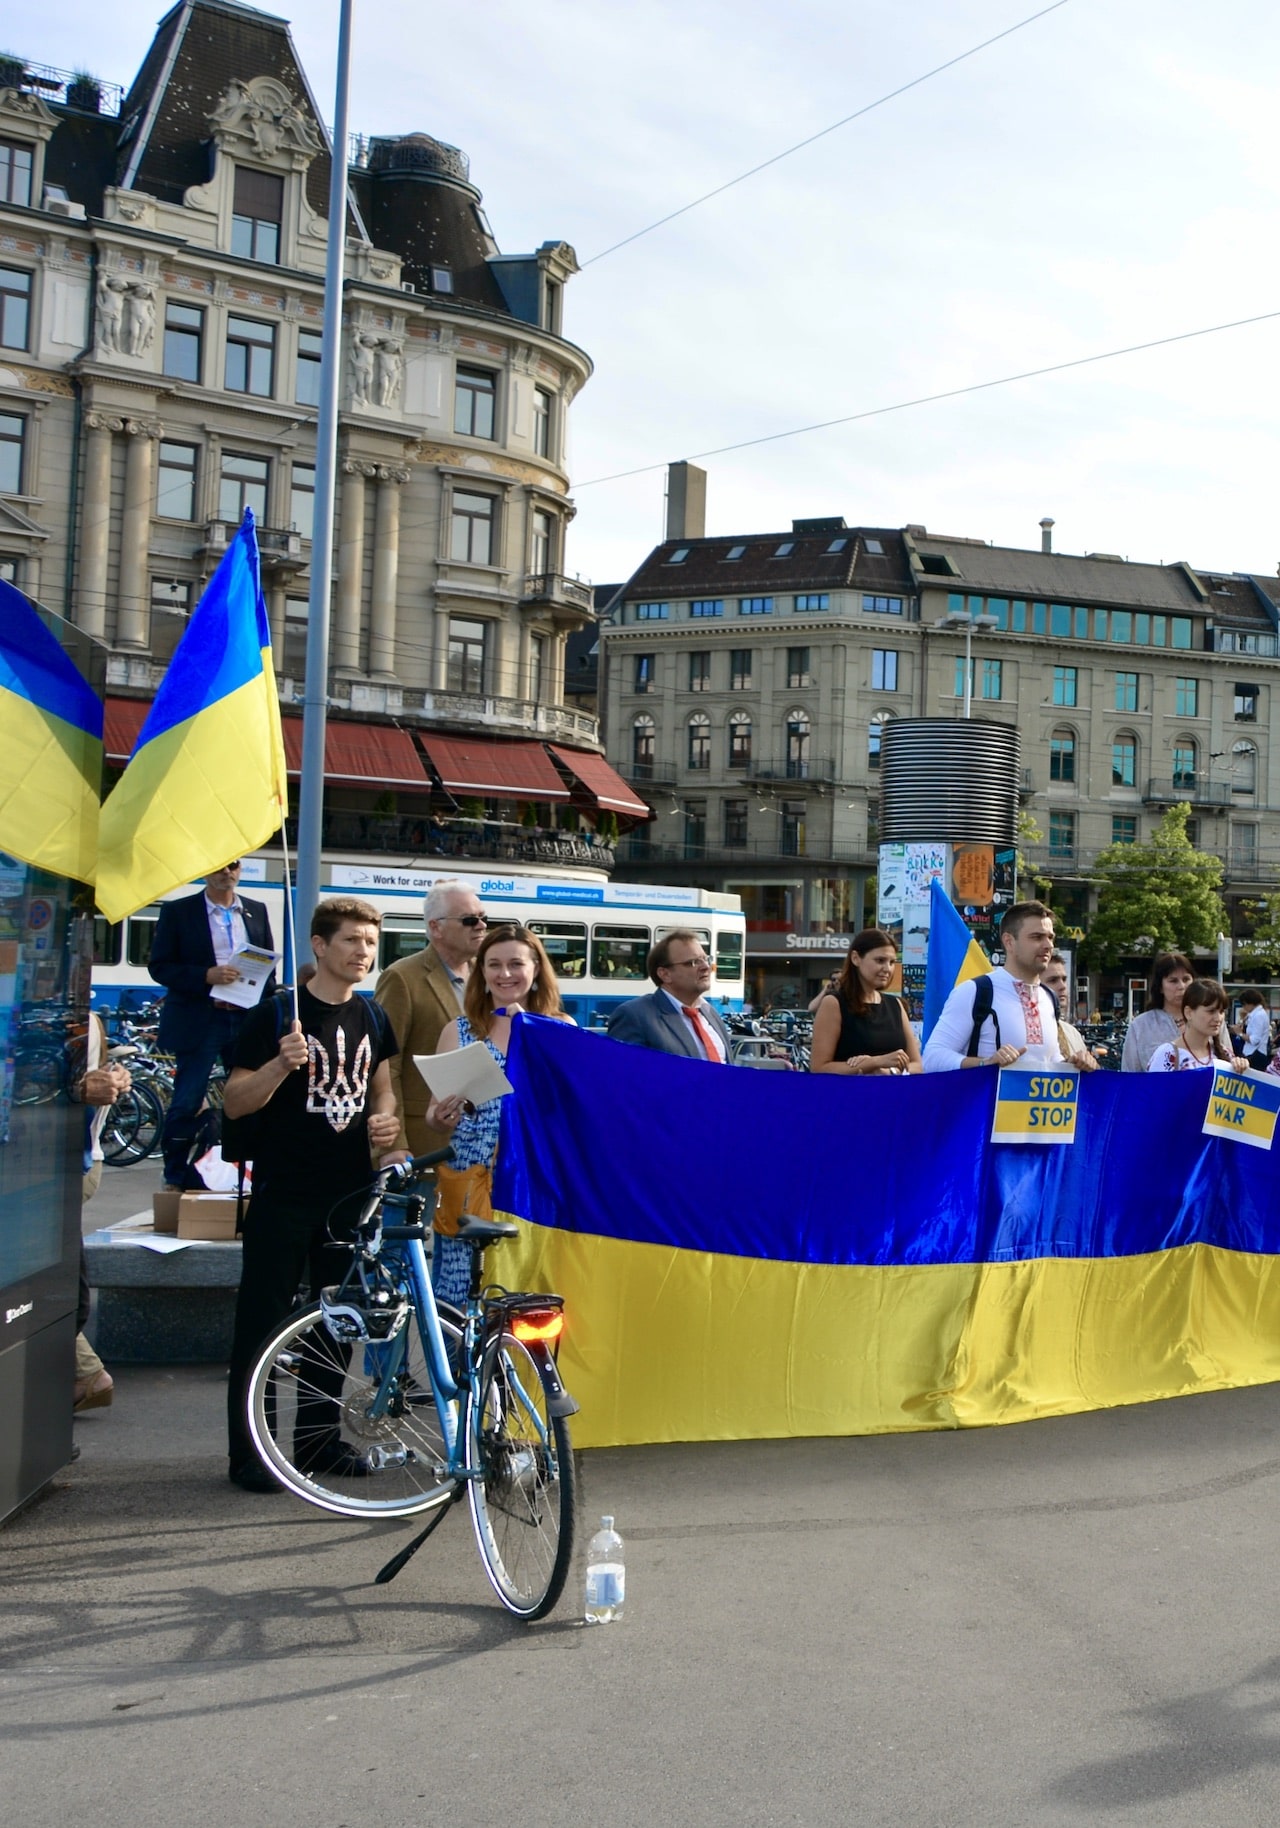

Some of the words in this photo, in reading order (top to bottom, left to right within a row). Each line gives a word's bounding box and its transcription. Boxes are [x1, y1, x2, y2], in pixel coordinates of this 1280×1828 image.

[373, 875, 395, 885] Work
[398, 876, 410, 886] for
[413, 879, 432, 887] care
[481, 879, 514, 892] global
[786, 933, 850, 949] Sunrise
[1029, 1077, 1074, 1098] STOP
[1215, 1075, 1256, 1101] PUTIN
[1028, 1106, 1073, 1127] STOP
[1214, 1101, 1246, 1126] WAR
